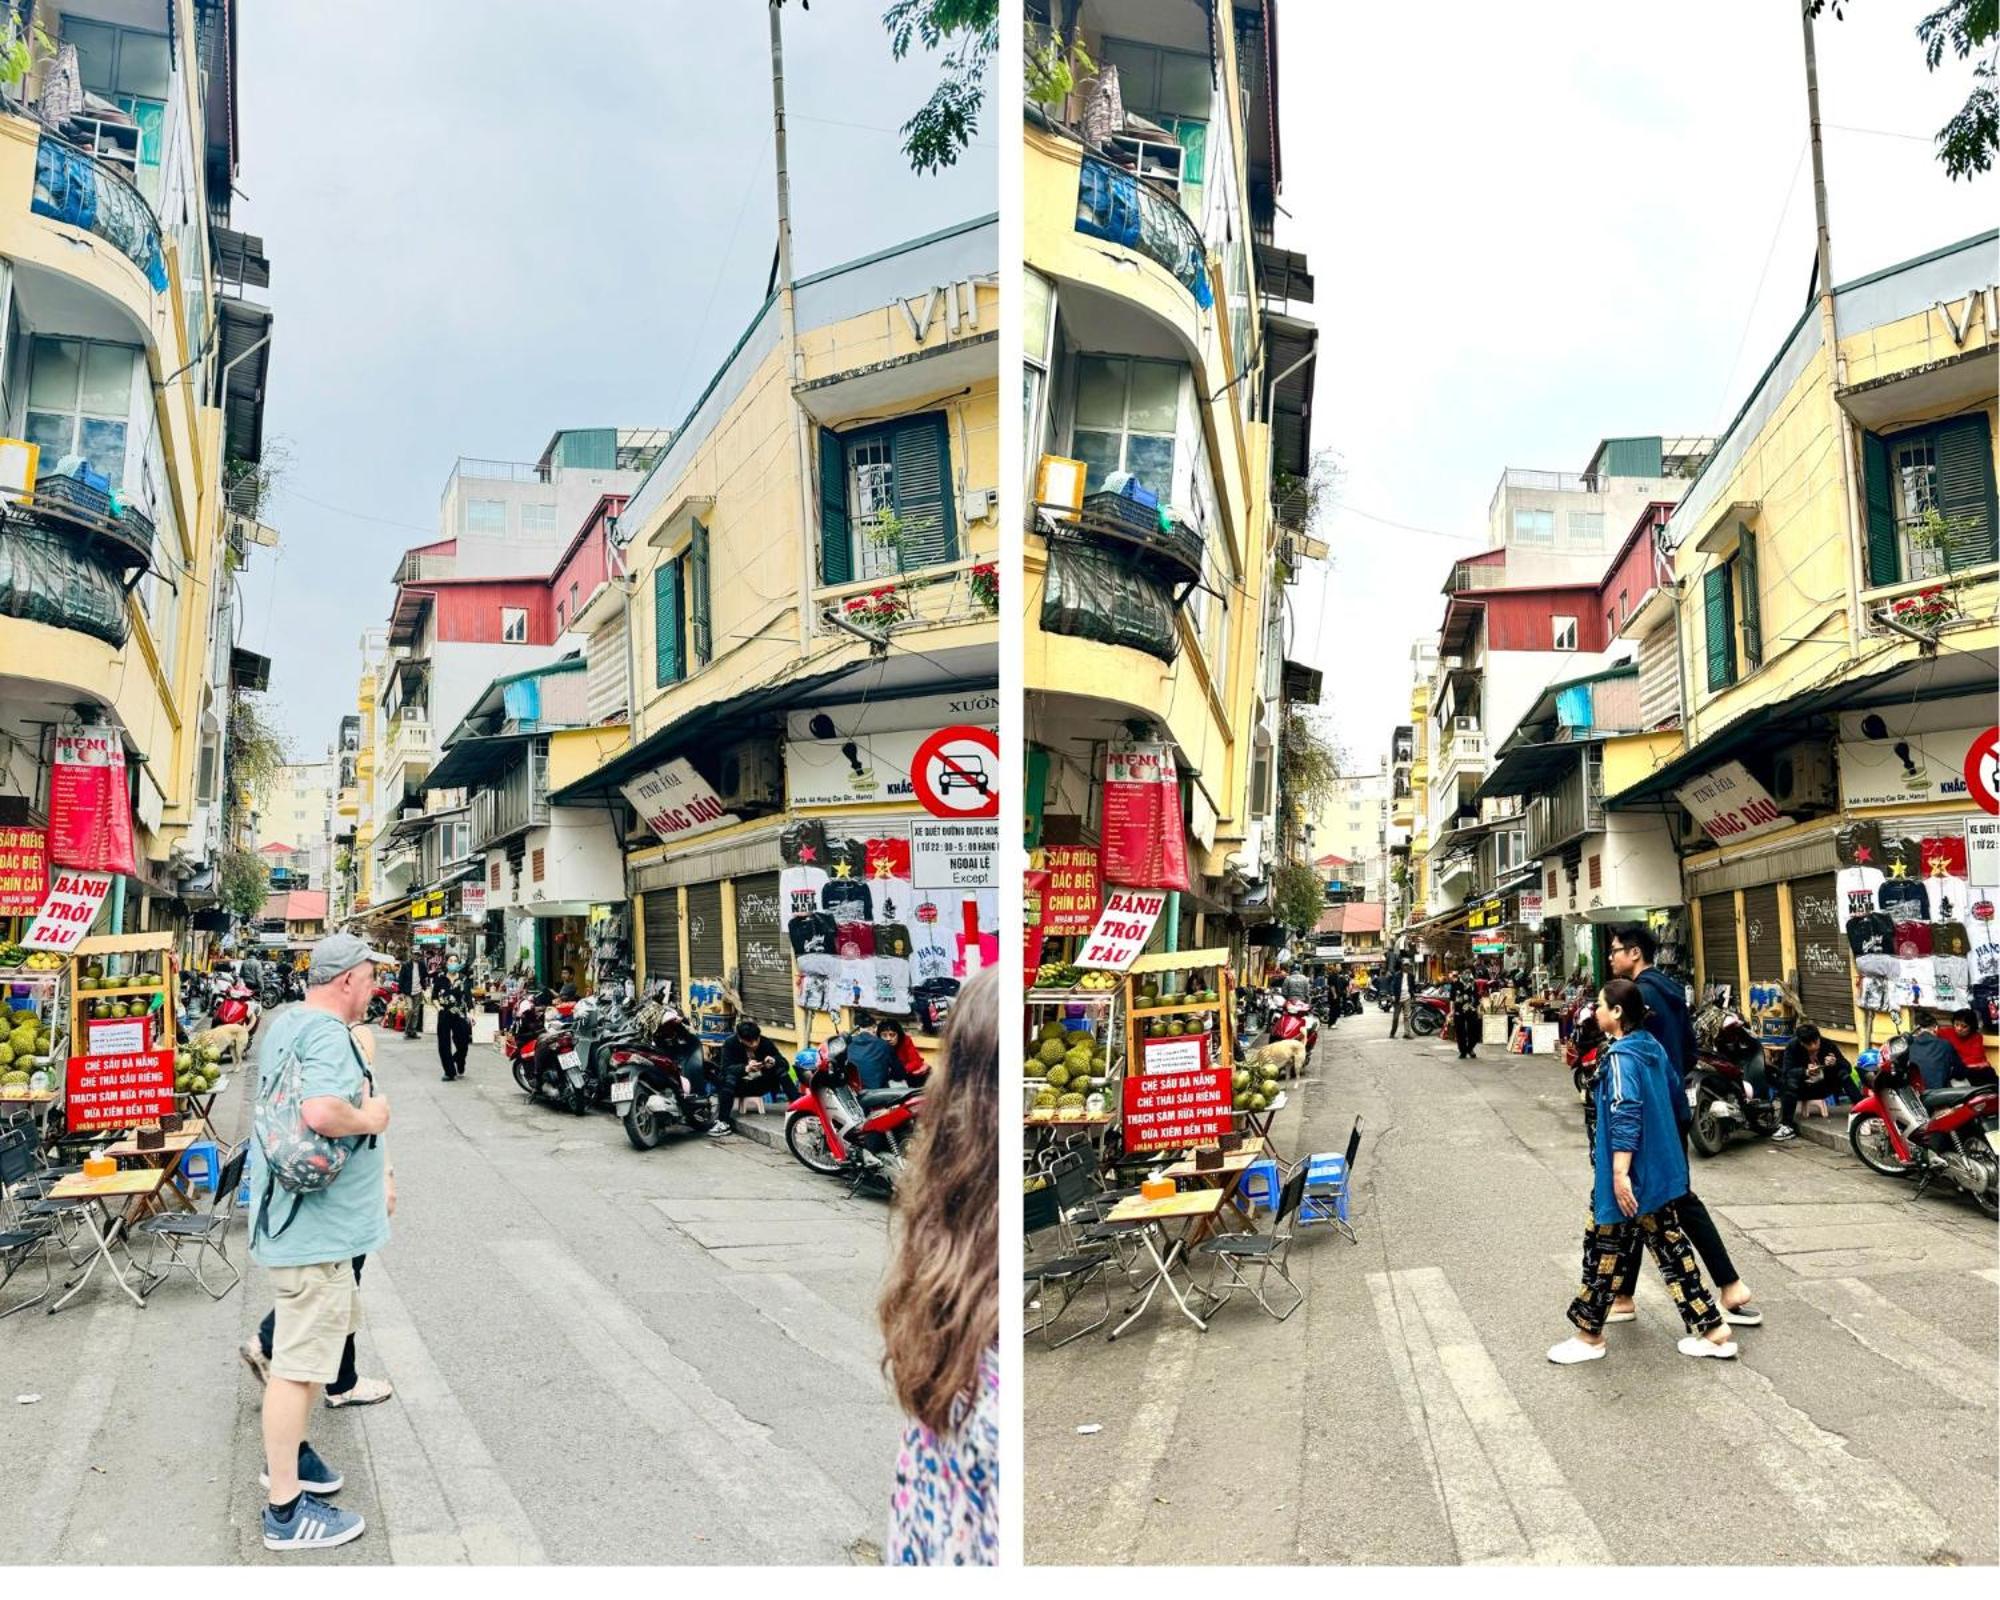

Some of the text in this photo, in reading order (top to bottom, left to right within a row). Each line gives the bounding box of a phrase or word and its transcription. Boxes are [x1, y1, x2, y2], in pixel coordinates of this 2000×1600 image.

[914, 827, 923, 836] XE
[950, 855, 991, 871] NGOẠI LỆ
[54, 873, 109, 898] BÁNH
[952, 872, 989, 884] Except
[1107, 891, 1162, 915] BÁNH
[47, 901, 94, 923] TRÔI
[1100, 919, 1148, 941] TRÔI
[144, 1103, 160, 1114] TRE
[1203, 1122, 1219, 1133] TRE
